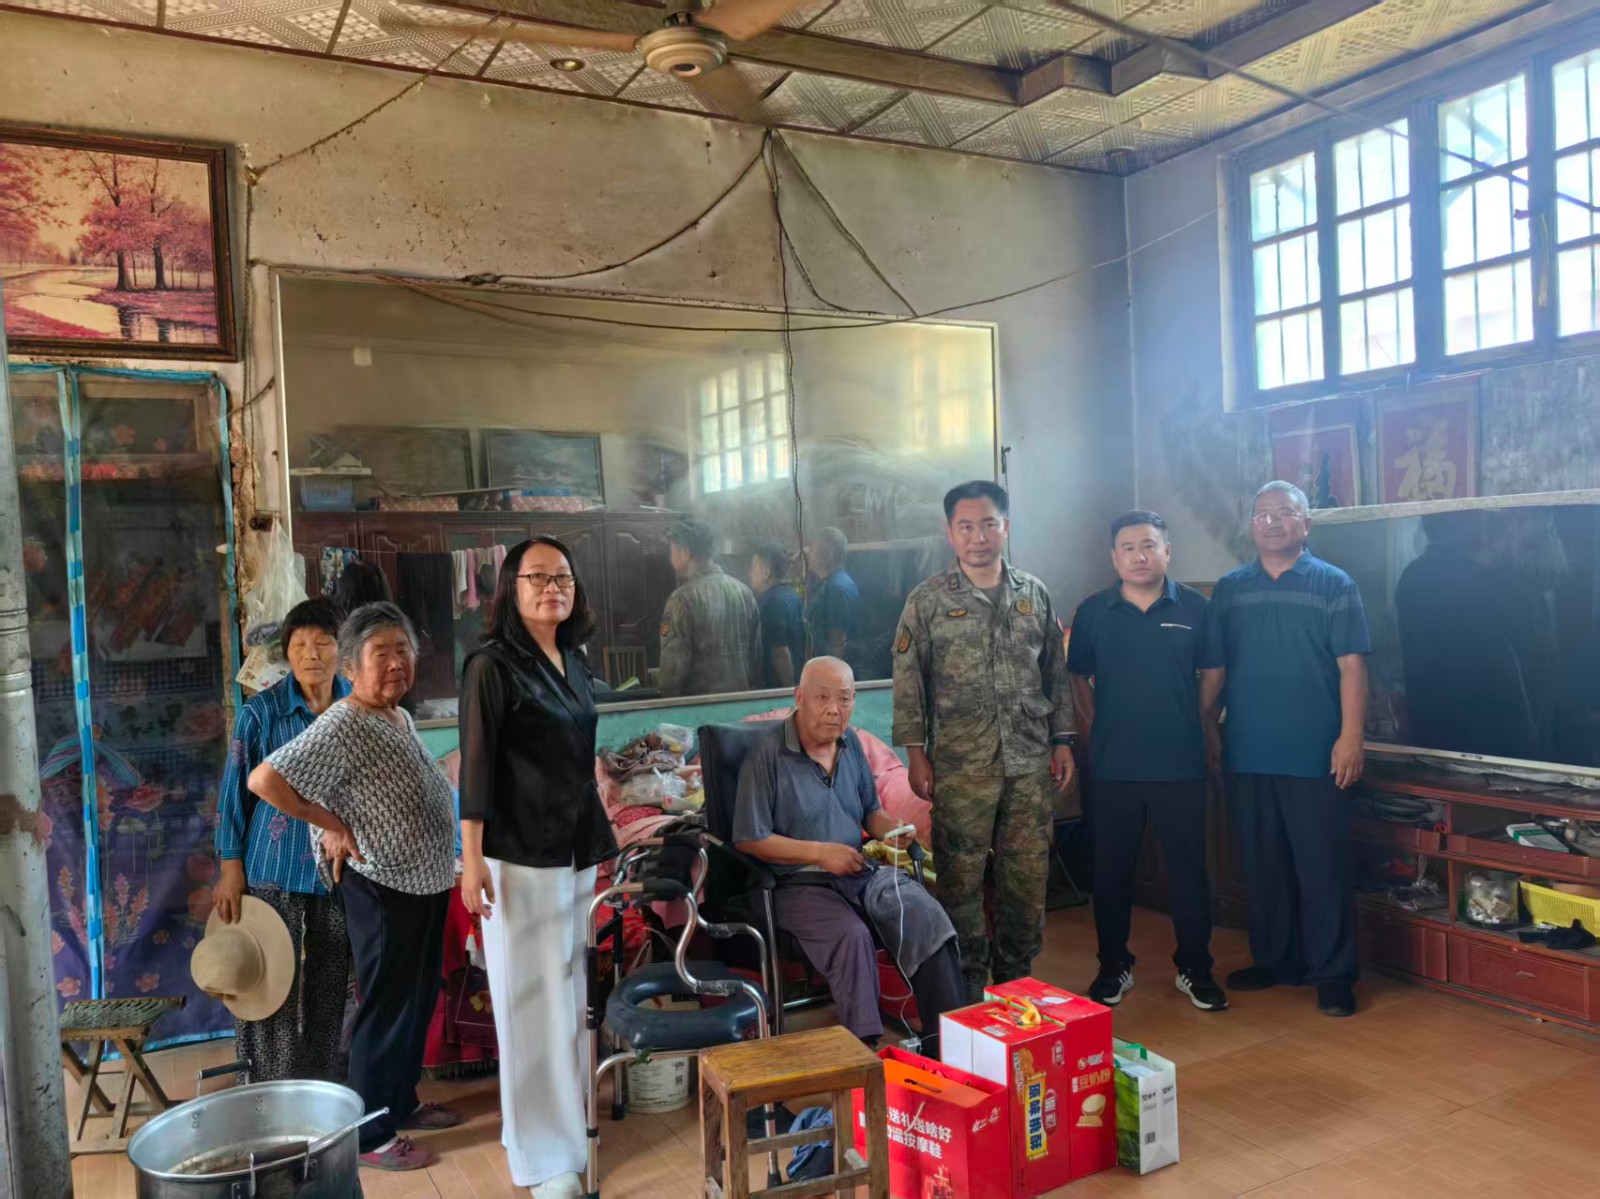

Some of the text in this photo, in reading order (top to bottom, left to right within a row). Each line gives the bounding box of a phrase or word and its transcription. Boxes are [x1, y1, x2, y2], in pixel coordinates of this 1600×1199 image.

[887, 1105, 952, 1143] 送礼送啥好
